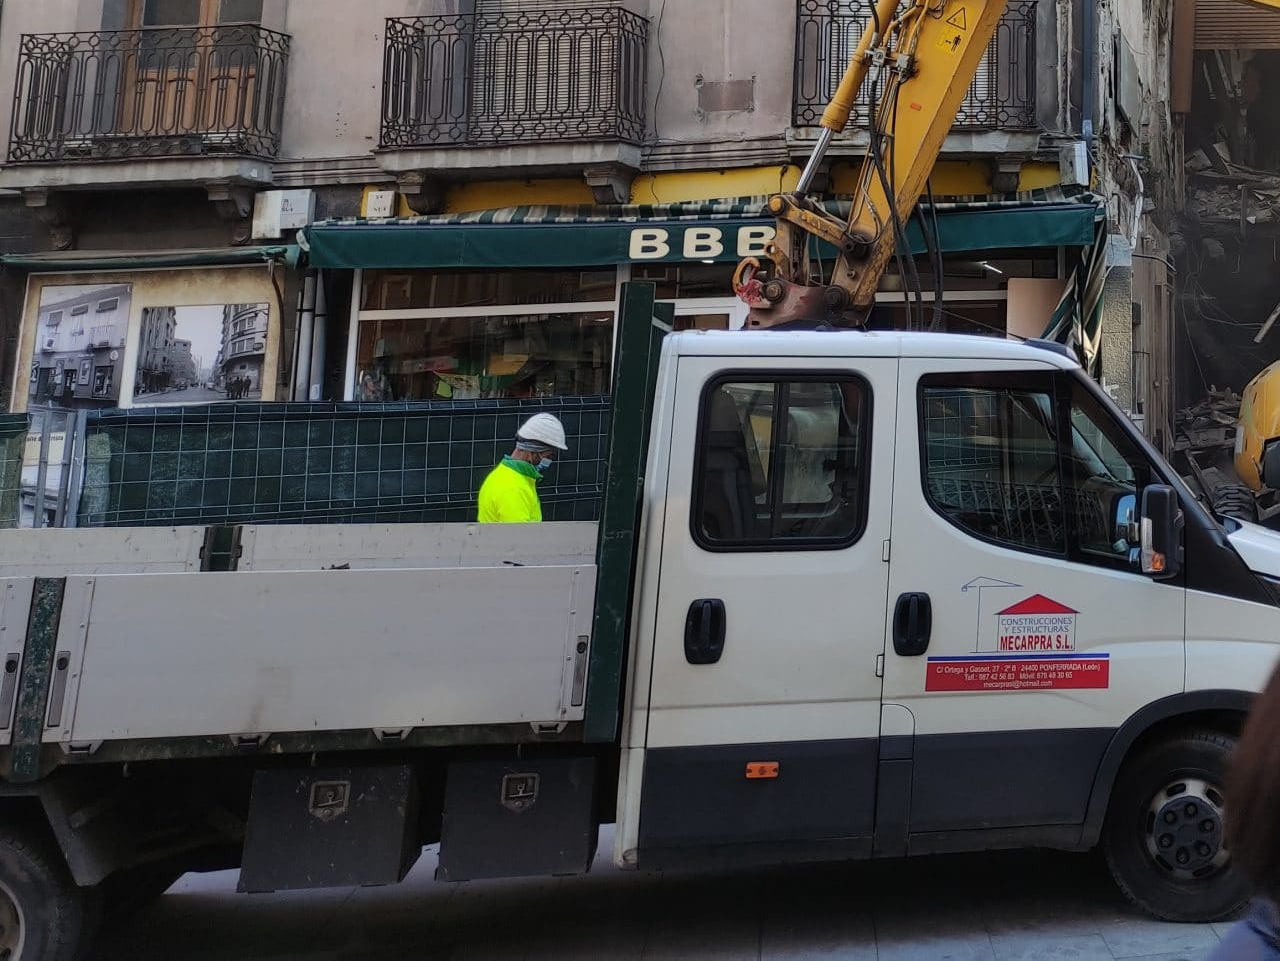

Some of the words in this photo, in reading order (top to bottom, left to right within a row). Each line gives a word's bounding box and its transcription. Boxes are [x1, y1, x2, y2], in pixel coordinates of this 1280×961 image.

[1001, 617, 1073, 627] CONSTRUCCIONES
[1004, 626, 1010, 634] Y
[1012, 625, 1069, 634] ESTRUCTURAS
[1000, 635, 1053, 651] MECARPRA
[1056, 634, 1074, 650] S.L.
[944, 666, 964, 675] Ortega
[1040, 663, 1082, 671] PONFERRADA
